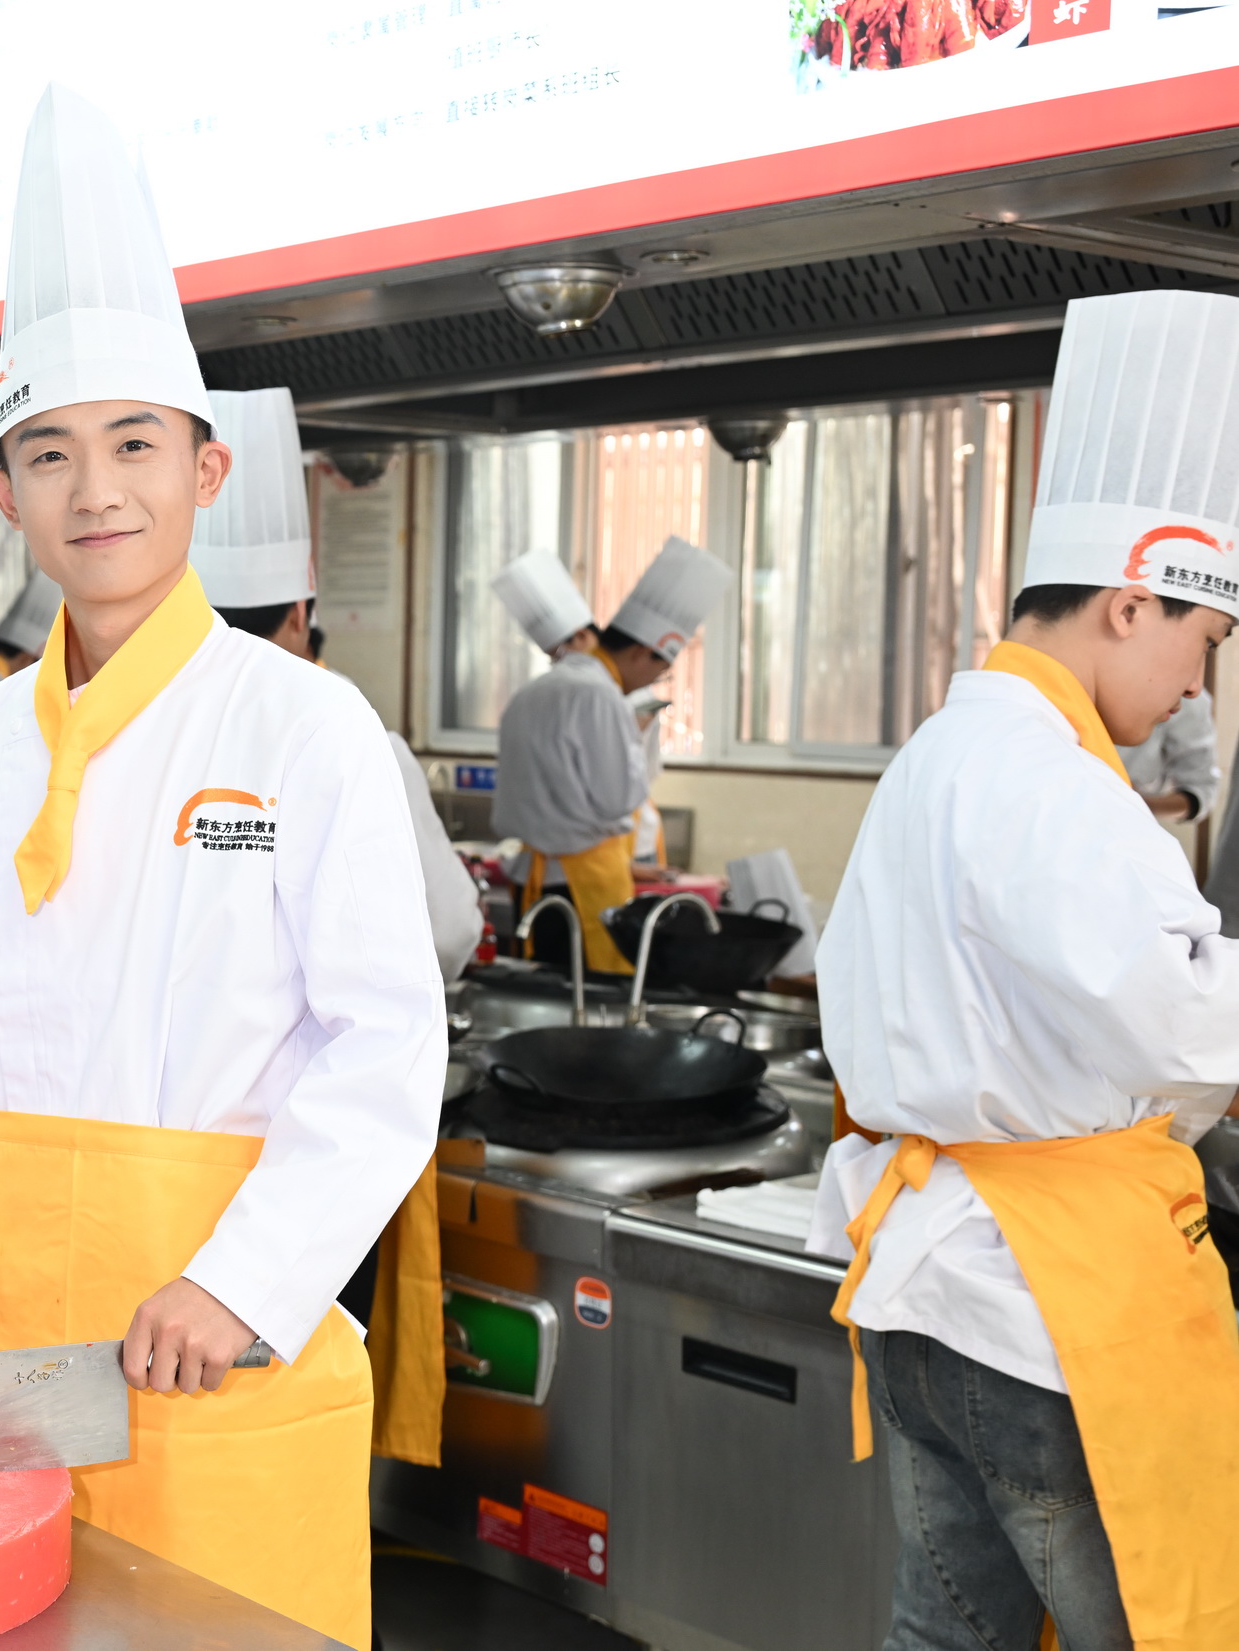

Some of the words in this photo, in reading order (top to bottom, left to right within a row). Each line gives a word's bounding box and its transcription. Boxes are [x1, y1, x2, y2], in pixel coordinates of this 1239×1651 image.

[7, 397, 32, 417] EDUCATION
[195, 817, 277, 834] 新东方烹饪教育
[194, 832, 209, 840] NEW
